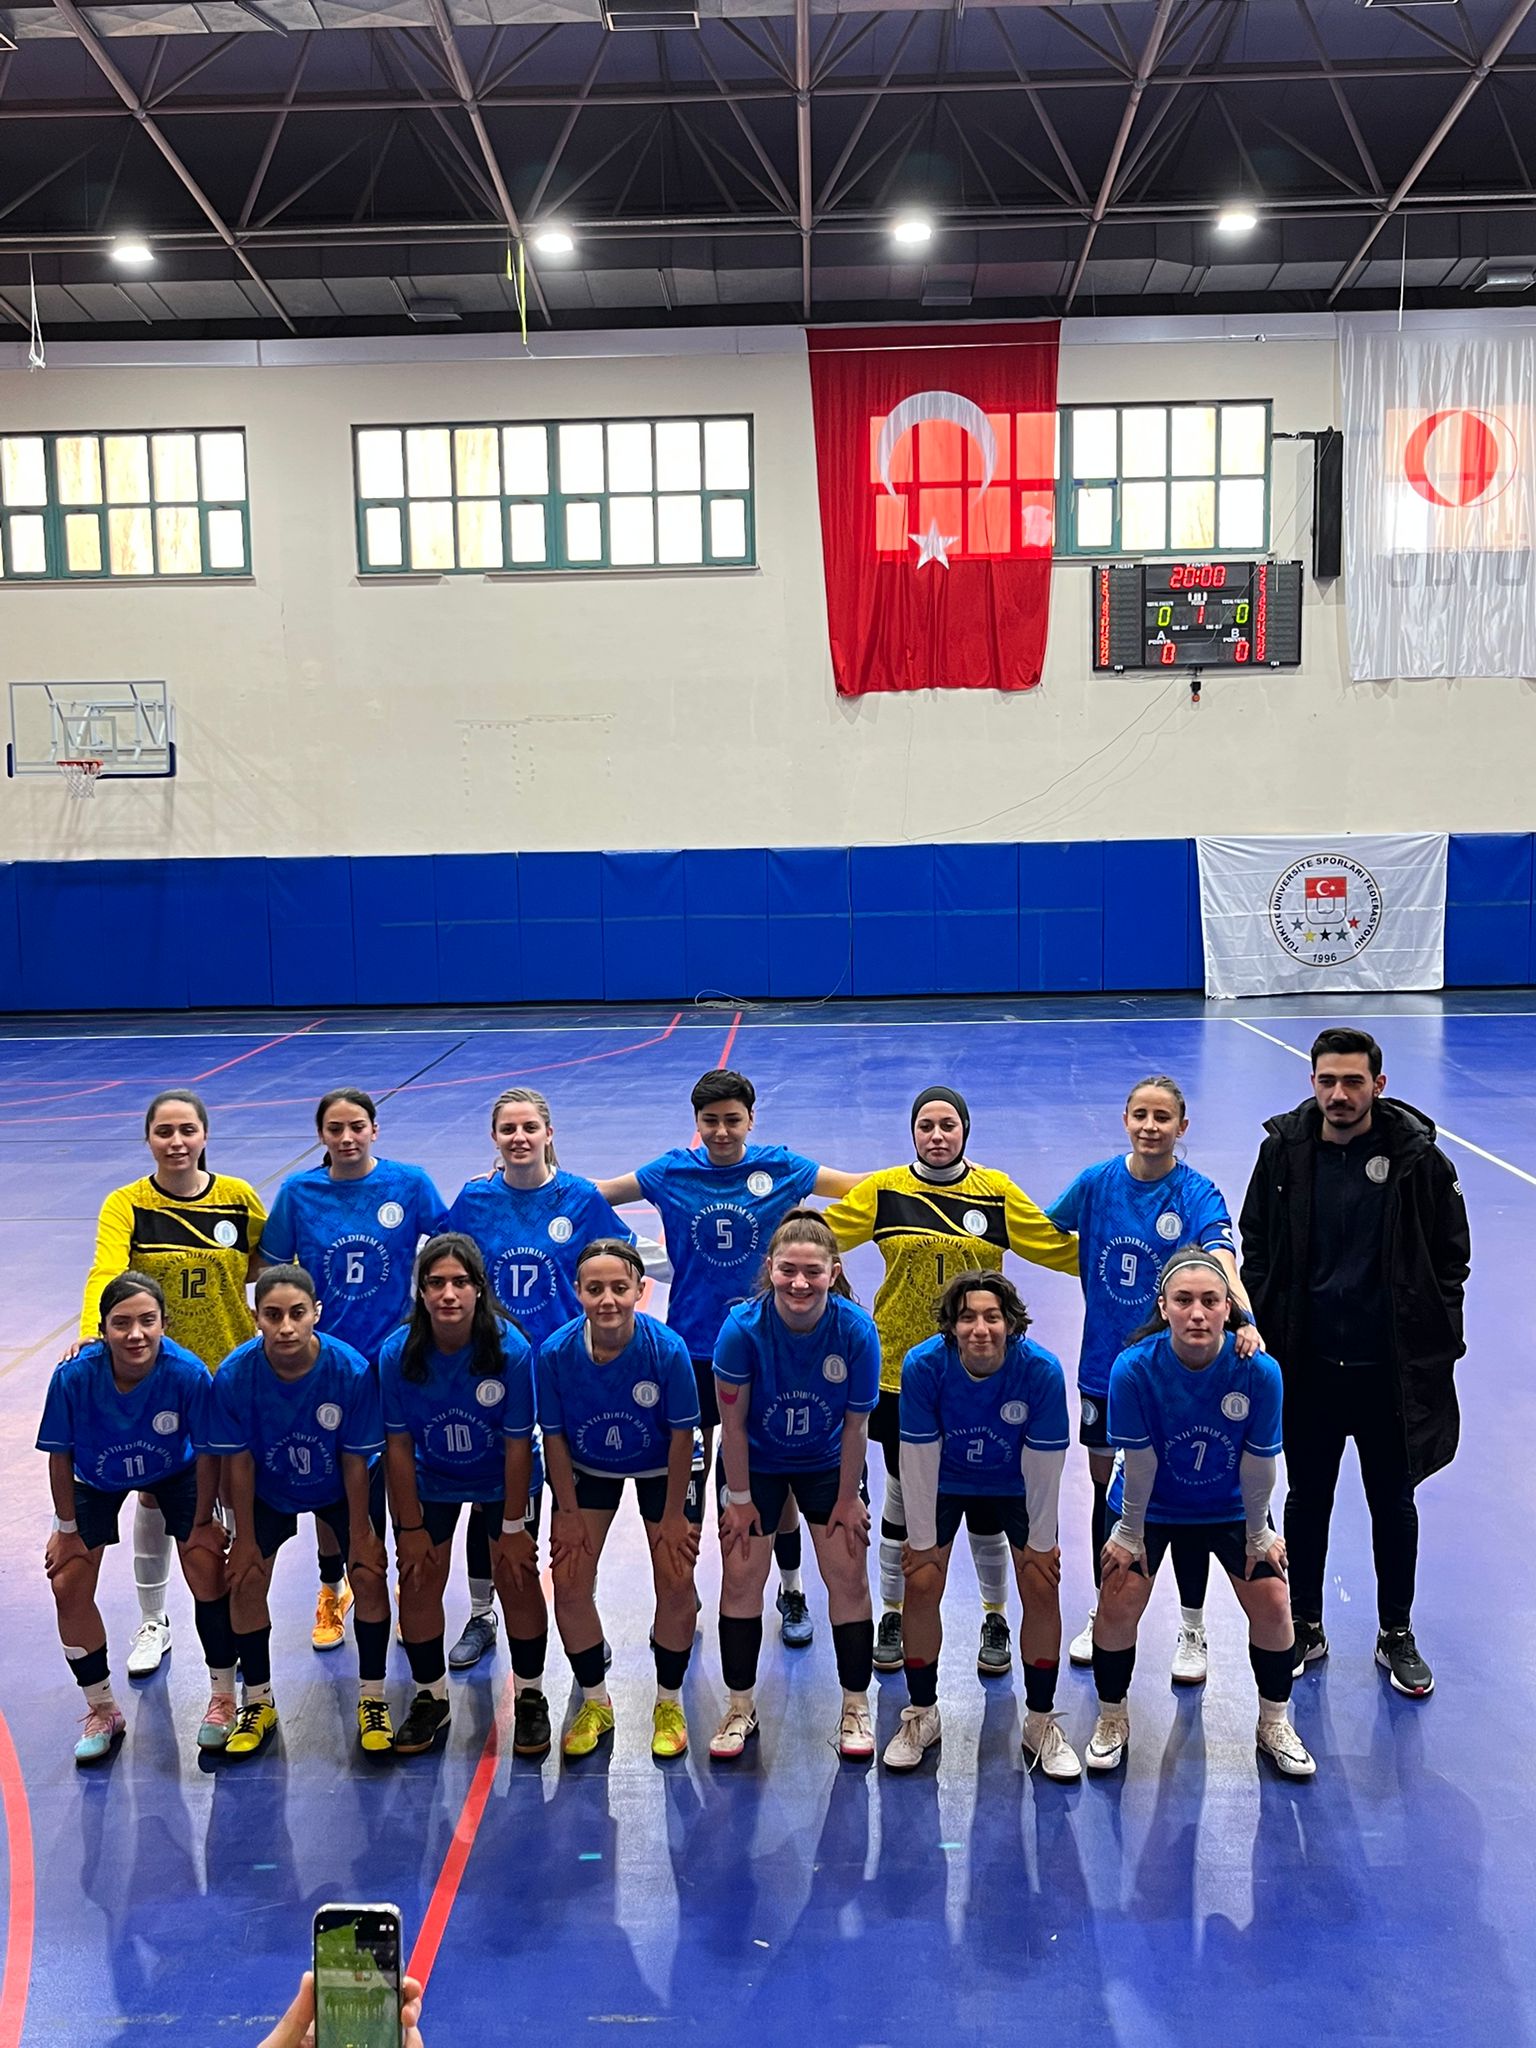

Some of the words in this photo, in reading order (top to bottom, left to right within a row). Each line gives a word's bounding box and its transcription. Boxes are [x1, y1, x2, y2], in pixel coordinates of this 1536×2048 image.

[1170, 565, 1226, 588] 20:00
[1158, 606, 1171, 626] 0
[1198, 606, 1205, 624] 1
[1236, 604, 1249, 624] 0
[1157, 630, 1166, 640] A
[1231, 628, 1239, 638] B
[1161, 642, 1176, 664] 0
[1235, 641, 1250, 662] 0
[1273, 860, 1314, 911] ÜNİVERSİTE
[1316, 857, 1365, 879] SPORLARI
[1354, 878, 1379, 949] FEDERASYONU
[1313, 953, 1337, 963] 1996
[700, 1203, 747, 1215] YILDIRIM
[745, 1213, 759, 1249] BEYAZIT
[716, 1219, 732, 1249] 5
[332, 1234, 378, 1248] YILDIRIM
[501, 1247, 547, 1260] YILDIRIM
[1099, 1245, 1111, 1282] ANKARA
[1110, 1236, 1152, 1254] YILDIRIM
[346, 1251, 364, 1283] 6
[935, 1253, 944, 1285] 1
[1120, 1253, 1137, 1286] 9
[181, 1268, 206, 1298] 12
[509, 1265, 538, 1297] 17
[785, 1406, 809, 1436] 13
[1174, 1425, 1221, 1441] YILDIRIM
[443, 1424, 472, 1452] 10
[605, 1425, 622, 1450] 4
[967, 1439, 984, 1463] 2
[1191, 1441, 1207, 1472] 7
[123, 1455, 145, 1478] 11
